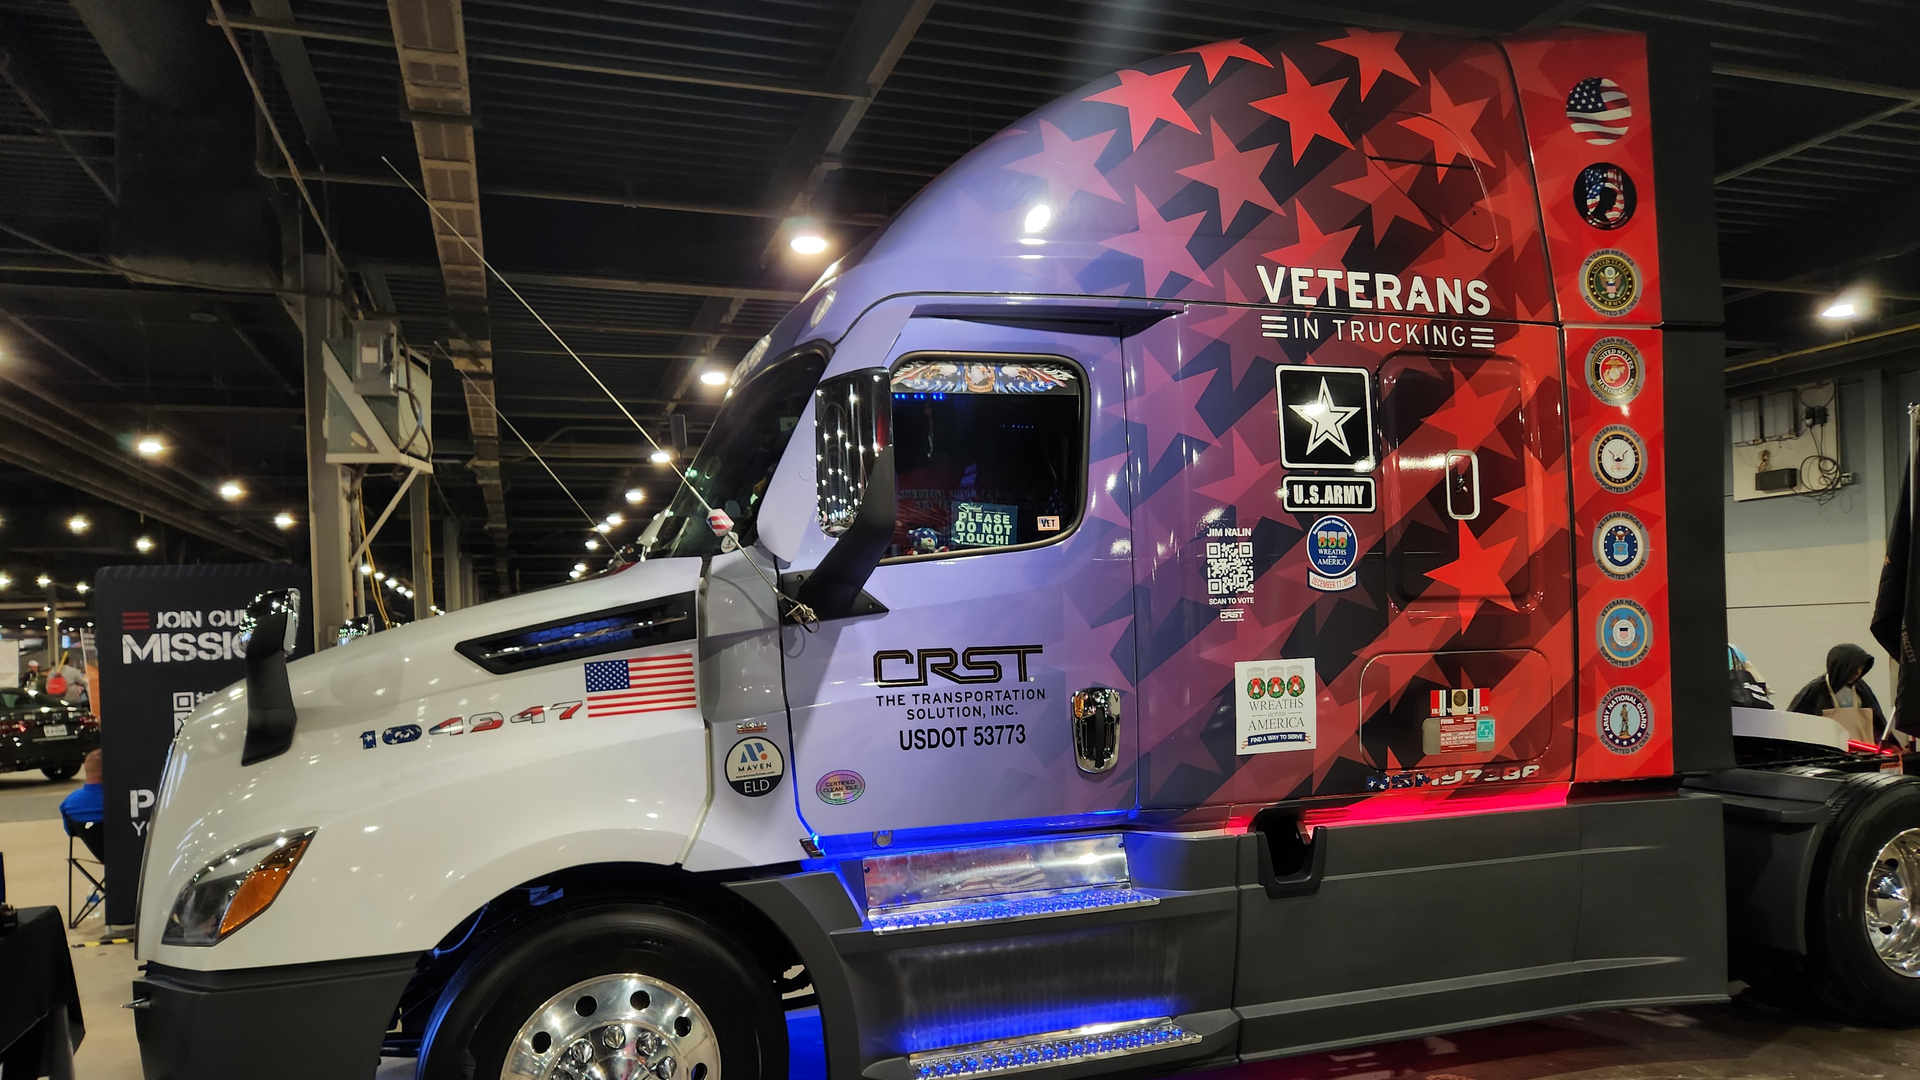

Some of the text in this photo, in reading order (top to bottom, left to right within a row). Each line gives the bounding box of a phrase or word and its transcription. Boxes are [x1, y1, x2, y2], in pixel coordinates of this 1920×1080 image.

[1256, 265, 1491, 316] VETERANS
[1293, 317, 1466, 347] IN TRUCKING
[1596, 349, 1616, 364] UNITED
[958, 512, 1010, 524] PLEASE
[1041, 519, 1056, 527] VET
[1597, 512, 1643, 530] VETERAN HEROES
[956, 521, 1012, 535] DO NOT
[1207, 528, 1252, 537] JIM NALIN
[958, 533, 1008, 545] TOUCH!
[1597, 559, 1626, 580] SUPPORTED
[1635, 559, 1646, 573] CRST
[1312, 577, 1335, 588] DECEMBER
[1601, 599, 1646, 617] VETERAN HEROES
[156, 610, 202, 628] JOIN
[1902, 631, 1916, 663] SUCCESS
[1600, 646, 1629, 667] SUPPORTED
[1638, 646, 1649, 660] CRST
[873, 644, 1043, 688] CRST
[876, 688, 1046, 706] THE TRANSPORTATION
[1602, 687, 1647, 704] VETERAN HEROES
[906, 704, 1018, 720] SOLUTION, INC.
[1249, 698, 1304, 711] WREATHS
[1608, 695, 1637, 710] NATIONAL
[1637, 703, 1647, 729] GUARD
[1248, 717, 1304, 731] AMERICA
[899, 724, 1026, 750] USDOT 53773
[1600, 734, 1630, 754] SUPPORTED
[736, 771, 775, 779] mavenmachines.com
[738, 762, 772, 772] MAVEN
[744, 780, 770, 793] ELD
